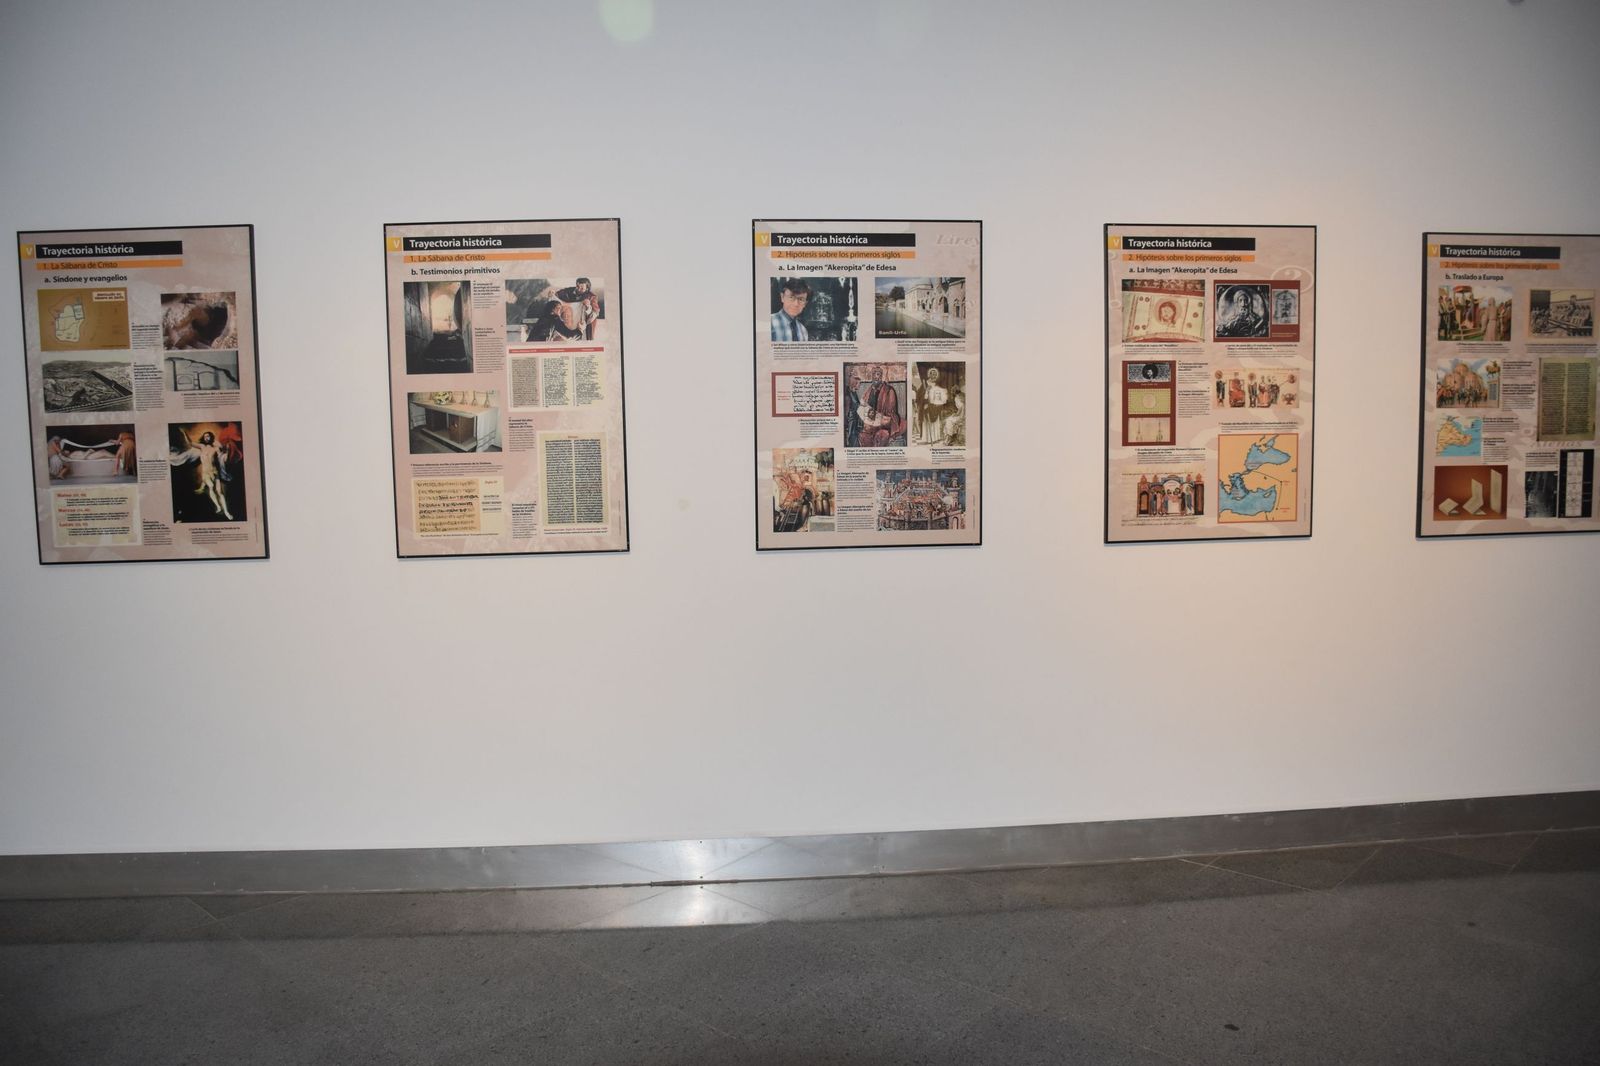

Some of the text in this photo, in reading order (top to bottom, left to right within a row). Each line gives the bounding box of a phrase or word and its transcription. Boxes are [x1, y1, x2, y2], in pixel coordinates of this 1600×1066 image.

[394, 240, 400, 248] V
[410, 238, 502, 249] Trayectoria histórica
[777, 234, 868, 245] Trayectoria histórica
[1128, 239, 1212, 248] Trayectoria histórica
[42, 245, 134, 256] Trayectoria histórica
[786, 250, 817, 259] Hipótesis
[850, 251, 880, 259] primeros
[881, 250, 901, 259] siglos
[1445, 247, 1521, 256] Trayectoria histórica
[465, 253, 486, 261] Cristo
[1136, 253, 1165, 262] Hipótesis
[1195, 254, 1223, 263] primeros
[1224, 254, 1242, 263] siglos
[420, 267, 463, 275] Testimonios
[464, 266, 501, 276] primitivos
[787, 263, 795, 271] La
[796, 263, 823, 272] Imagen
[866, 263, 875, 271] de
[876, 263, 897, 271] Edesa
[83, 276, 88, 284] y
[89, 274, 128, 283] evangelios
